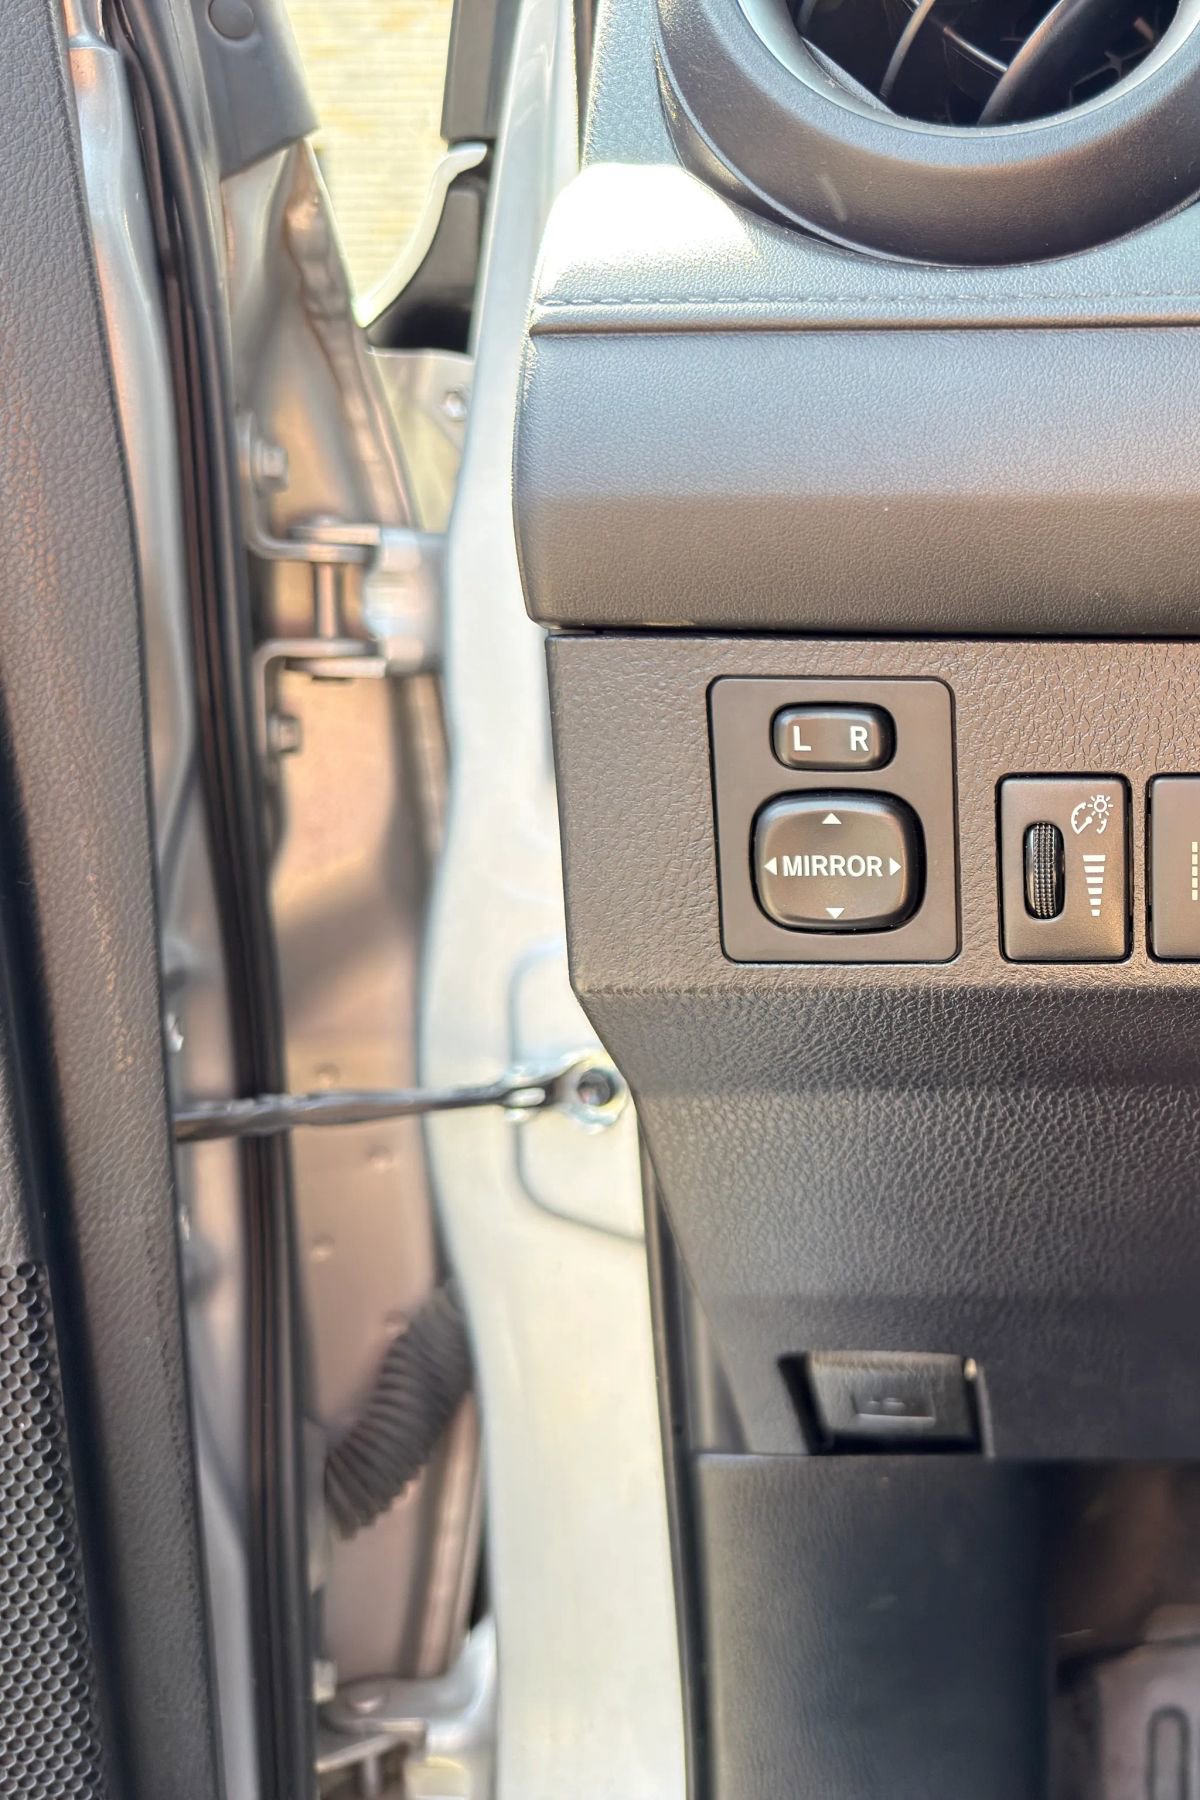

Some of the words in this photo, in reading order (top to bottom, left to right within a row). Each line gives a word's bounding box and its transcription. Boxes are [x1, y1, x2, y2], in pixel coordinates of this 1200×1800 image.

[792, 725, 812, 751] L
[849, 725, 870, 751] R
[782, 855, 884, 877] MIRROR
